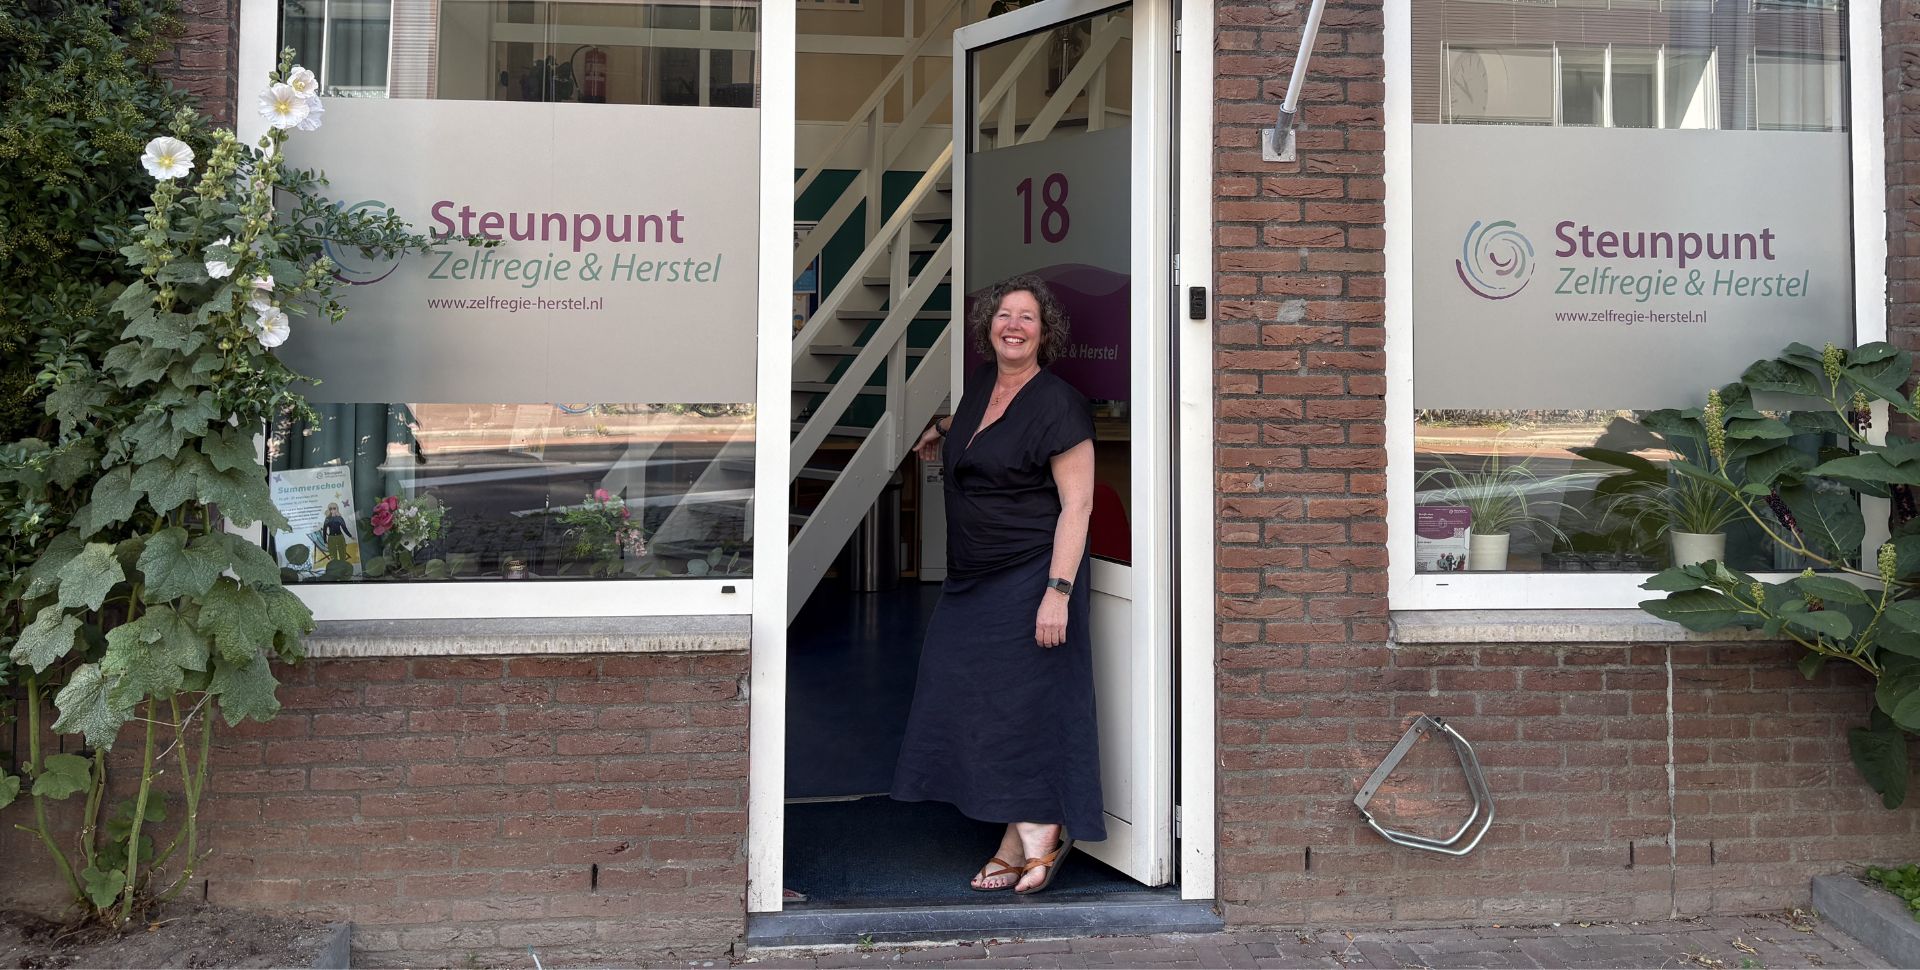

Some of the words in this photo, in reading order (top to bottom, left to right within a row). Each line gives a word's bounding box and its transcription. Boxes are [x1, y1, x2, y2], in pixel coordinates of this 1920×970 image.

[430, 200, 685, 252] Steunpunt
[1016, 172, 1070, 245] 18
[1554, 220, 1776, 269] Steunpunt
[427, 249, 572, 289] Zelfregie
[578, 252, 604, 282] &
[610, 253, 723, 283] Herstel
[1554, 266, 1678, 303] Zelfregie
[1684, 268, 1706, 296] &
[1712, 269, 1810, 297] Herstel
[427, 296, 604, 313] www.zelfregie-herstel.nl
[1554, 309, 1708, 326] www.zelfregie-herstel.nl
[1069, 343, 1077, 358] &
[1078, 343, 1119, 361] Herstel
[277, 481, 345, 494] Summerschool
